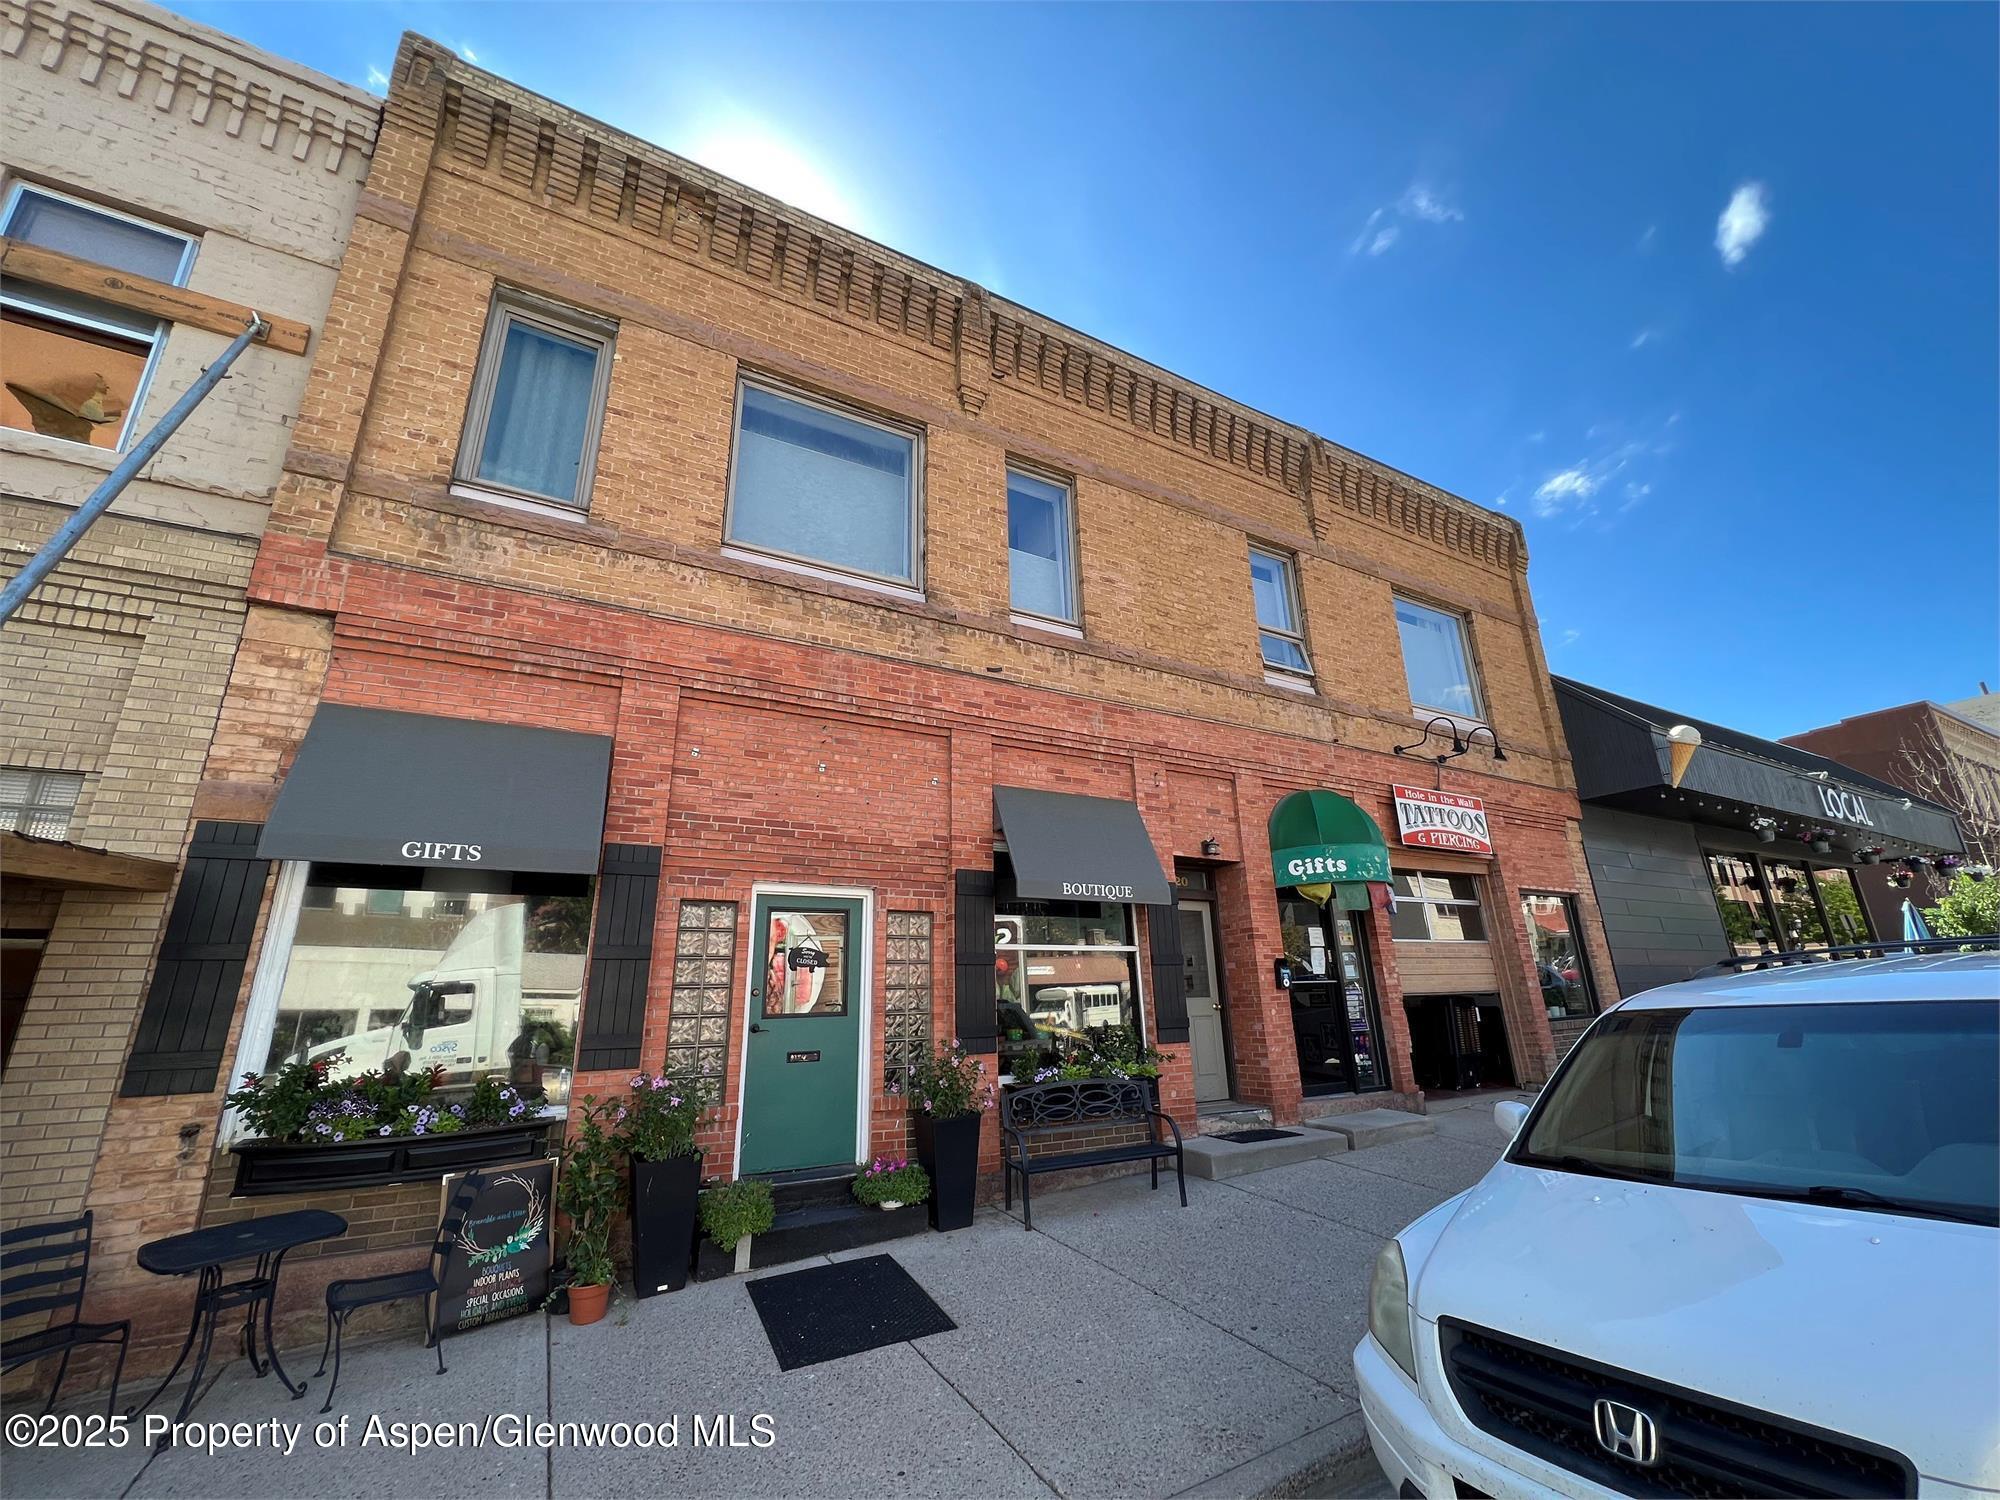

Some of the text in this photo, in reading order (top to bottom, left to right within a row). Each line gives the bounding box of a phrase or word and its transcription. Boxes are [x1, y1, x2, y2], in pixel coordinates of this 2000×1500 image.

[1405, 789, 1474, 809] Hole in the Wall
[1818, 785, 1874, 826] LOCAL
[1400, 802, 1487, 838] TATTOOS
[1430, 832, 1480, 850] PIERCING
[401, 841, 482, 862] GIFTS
[1288, 857, 1347, 876] Gifts
[1062, 882, 1134, 901] BOUTIQUE
[473, 1268, 520, 1288] INDOOR PLANTS
[466, 1285, 524, 1309] SPECIAL OCCASIONS
[458, 1316, 482, 1330] CUSTOM
